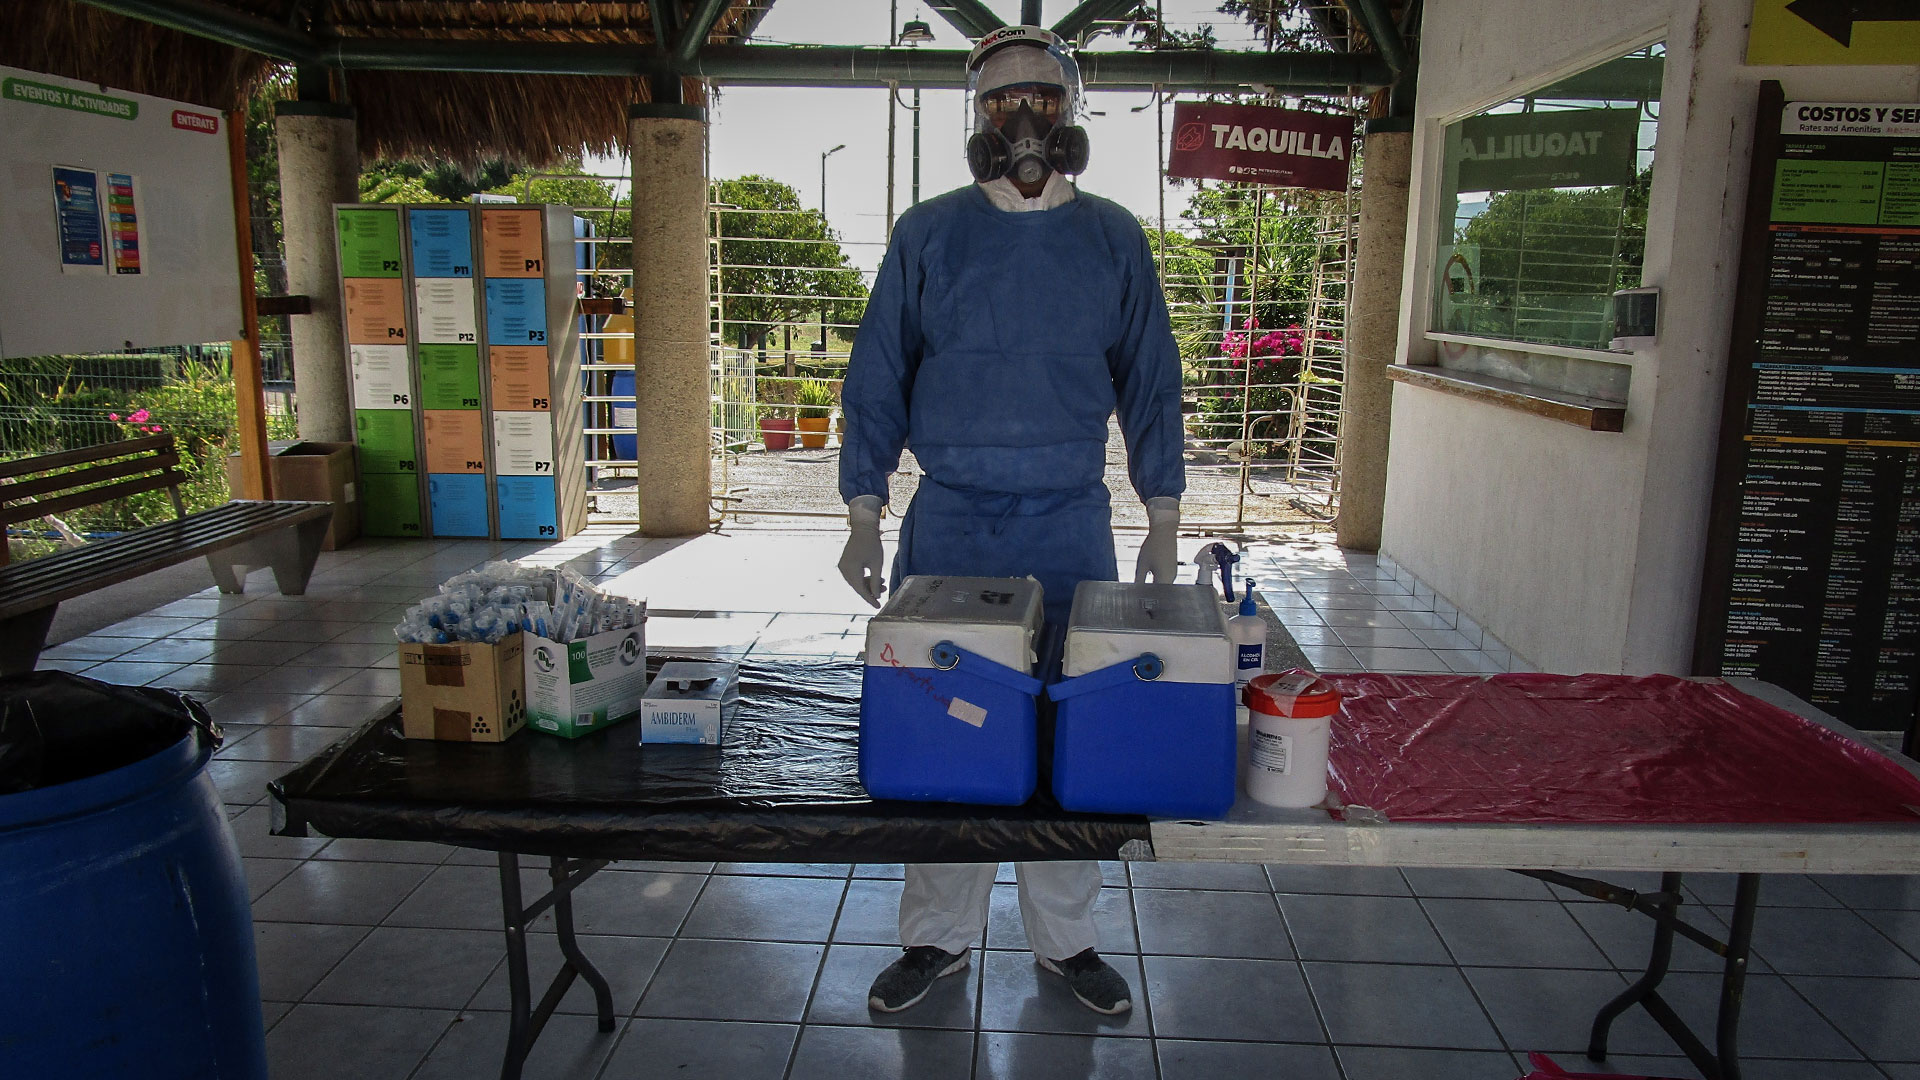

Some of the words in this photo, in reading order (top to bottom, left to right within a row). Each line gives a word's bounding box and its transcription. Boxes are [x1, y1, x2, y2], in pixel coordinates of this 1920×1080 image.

[13, 83, 62, 104] EVENTOS
[63, 93, 69, 104] Y
[71, 94, 130, 116] ACTIVIDADES
[1798, 106, 1870, 122] COSTOS
[1875, 108, 1888, 122] Y
[176, 113, 215, 130] ENTÉRATE
[1800, 124, 1821, 132] Rates
[1841, 125, 1881, 133] Amenities
[1212, 124, 1344, 160] TAQUILLA
[383, 261, 399, 271] P2
[454, 266, 469, 275] P11
[526, 260, 540, 272] P1
[388, 328, 404, 338] P4
[529, 330, 545, 341] P3
[394, 395, 408, 404] P6
[533, 399, 548, 408] P5
[400, 461, 414, 470] P8
[467, 461, 482, 469] P14
[535, 461, 550, 471] P7
[539, 526, 554, 535] P9
[572, 651, 585, 660] 100
[651, 712, 696, 725] AMBIDERM
